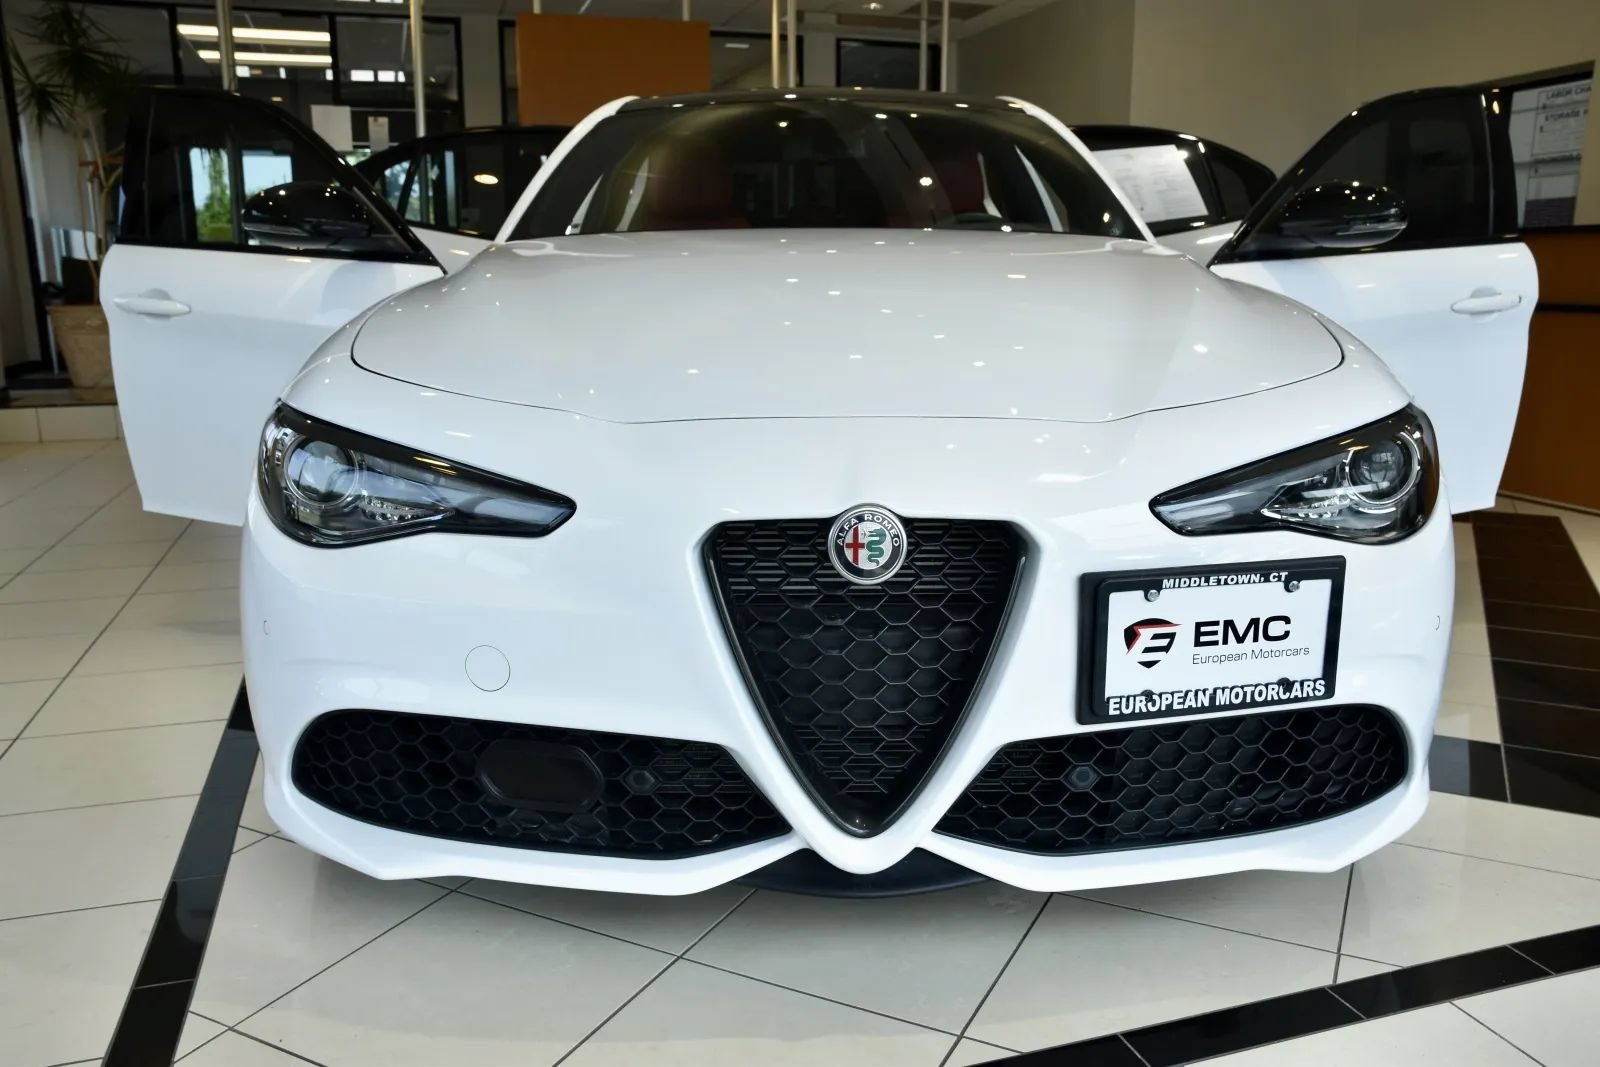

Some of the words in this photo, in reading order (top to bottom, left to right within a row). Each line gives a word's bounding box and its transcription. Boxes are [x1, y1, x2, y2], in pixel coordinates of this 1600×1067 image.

[837, 518, 859, 546] ALFA
[864, 513, 900, 546] ROMEO
[1162, 573, 1264, 589] MIDDLETOWN,
[1269, 572, 1288, 582] CT
[1193, 615, 1291, 647] EMC
[1192, 652, 1248, 664] European
[1251, 647, 1310, 660] Motorcars
[1108, 689, 1209, 715] EUROPEAN
[1215, 679, 1326, 706] MOTORCARS
